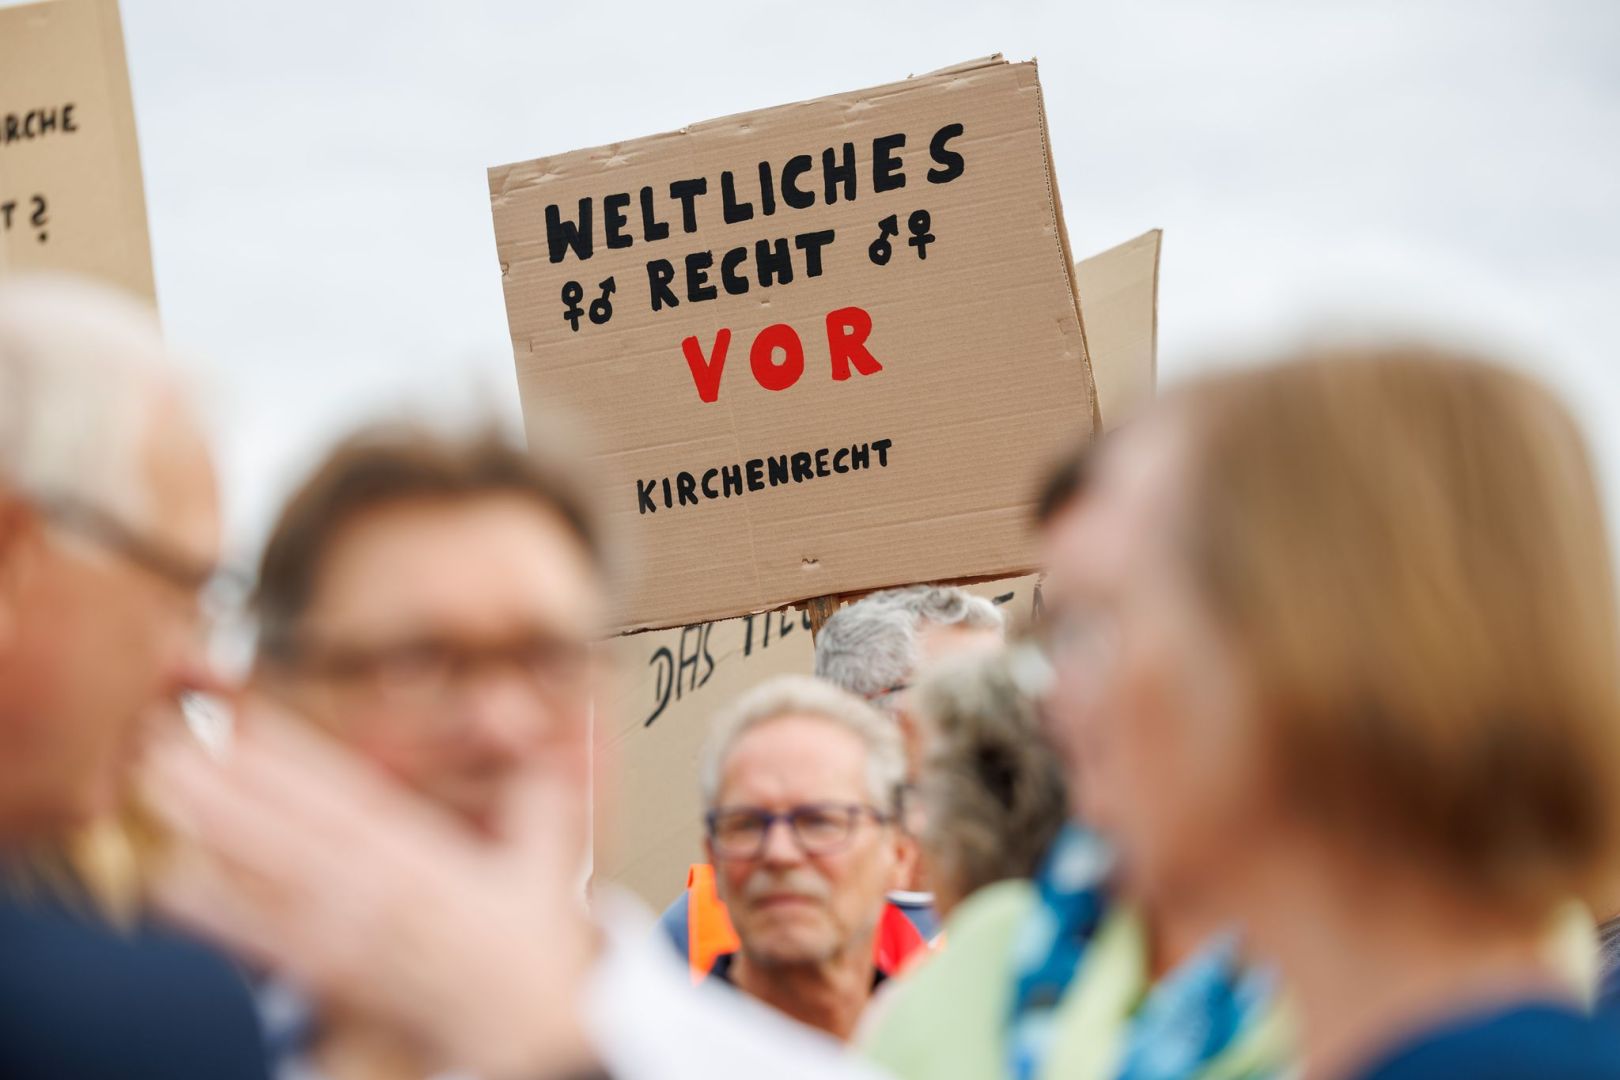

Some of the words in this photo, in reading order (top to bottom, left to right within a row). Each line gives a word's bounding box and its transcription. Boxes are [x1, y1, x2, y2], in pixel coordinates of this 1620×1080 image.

[0, 103, 78, 146] RCHE
[544, 122, 965, 264] WELTLICHES
[646, 229, 836, 312] RECHT
[681, 306, 883, 403] VOR
[636, 438, 892, 515] KIRCHENRECHT
[645, 622, 714, 728] DAS
